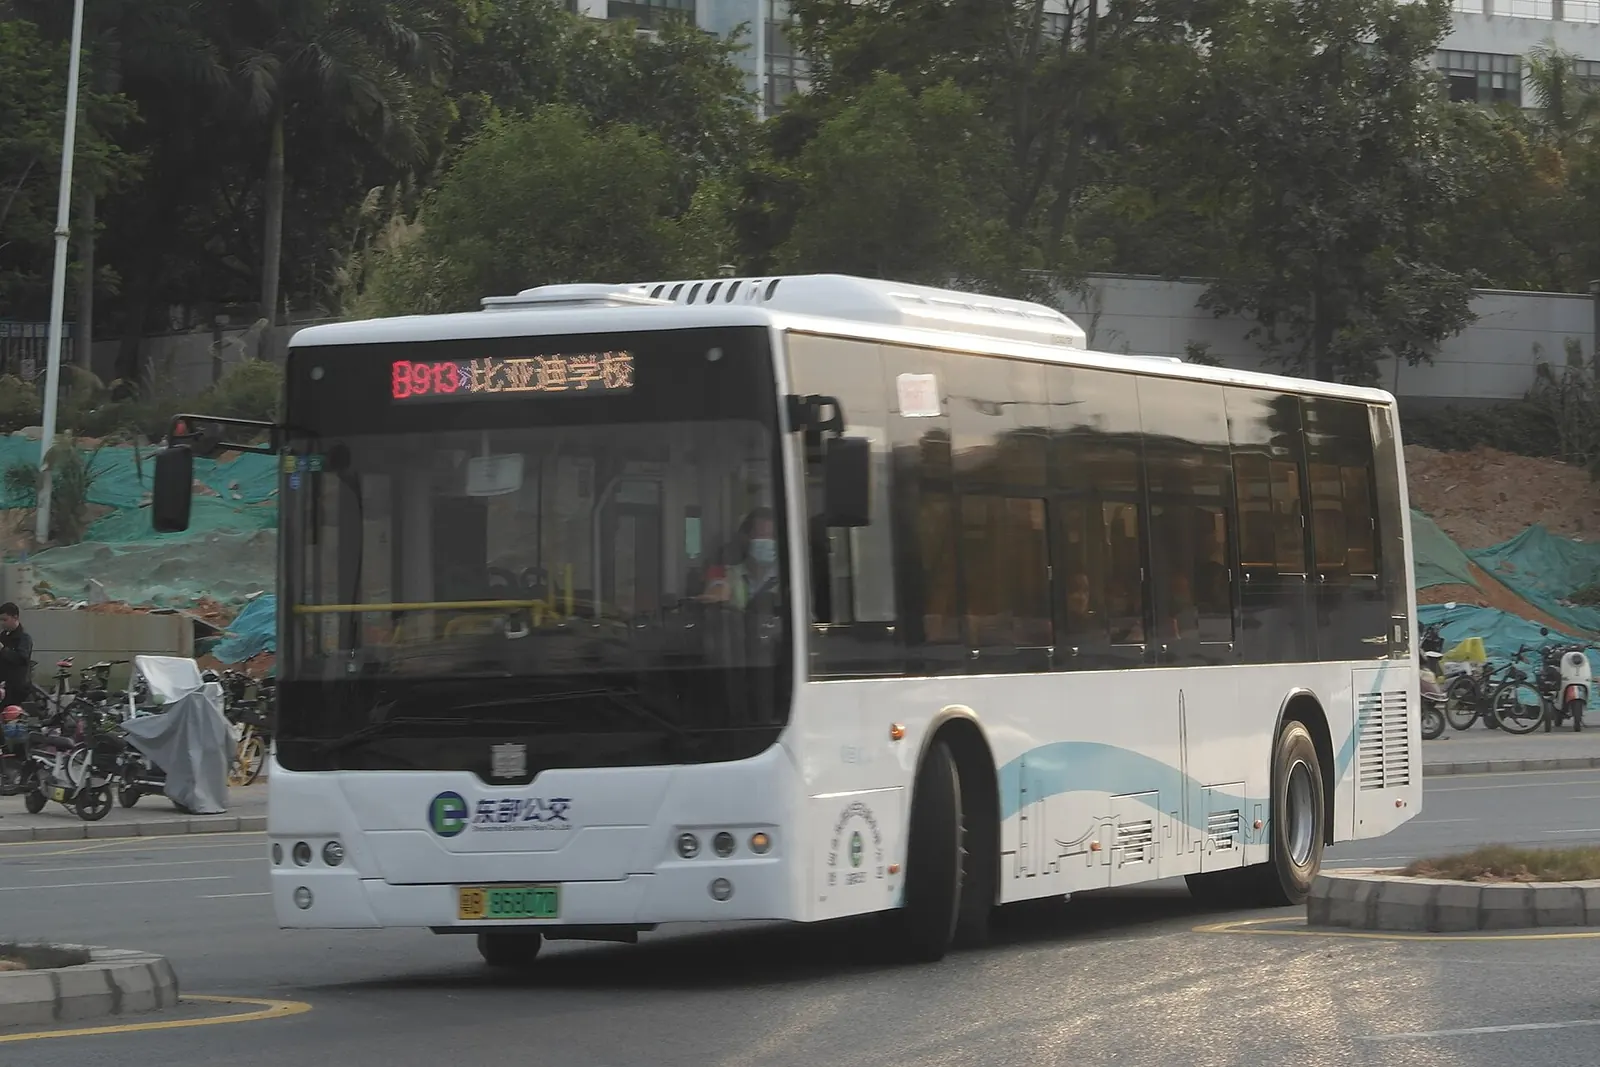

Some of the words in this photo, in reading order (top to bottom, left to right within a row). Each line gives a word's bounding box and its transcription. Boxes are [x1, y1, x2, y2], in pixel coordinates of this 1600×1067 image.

[392, 360, 458, 398] B913
[470, 351, 635, 392] 比亚迪学校
[471, 798, 574, 823] 东部公交
